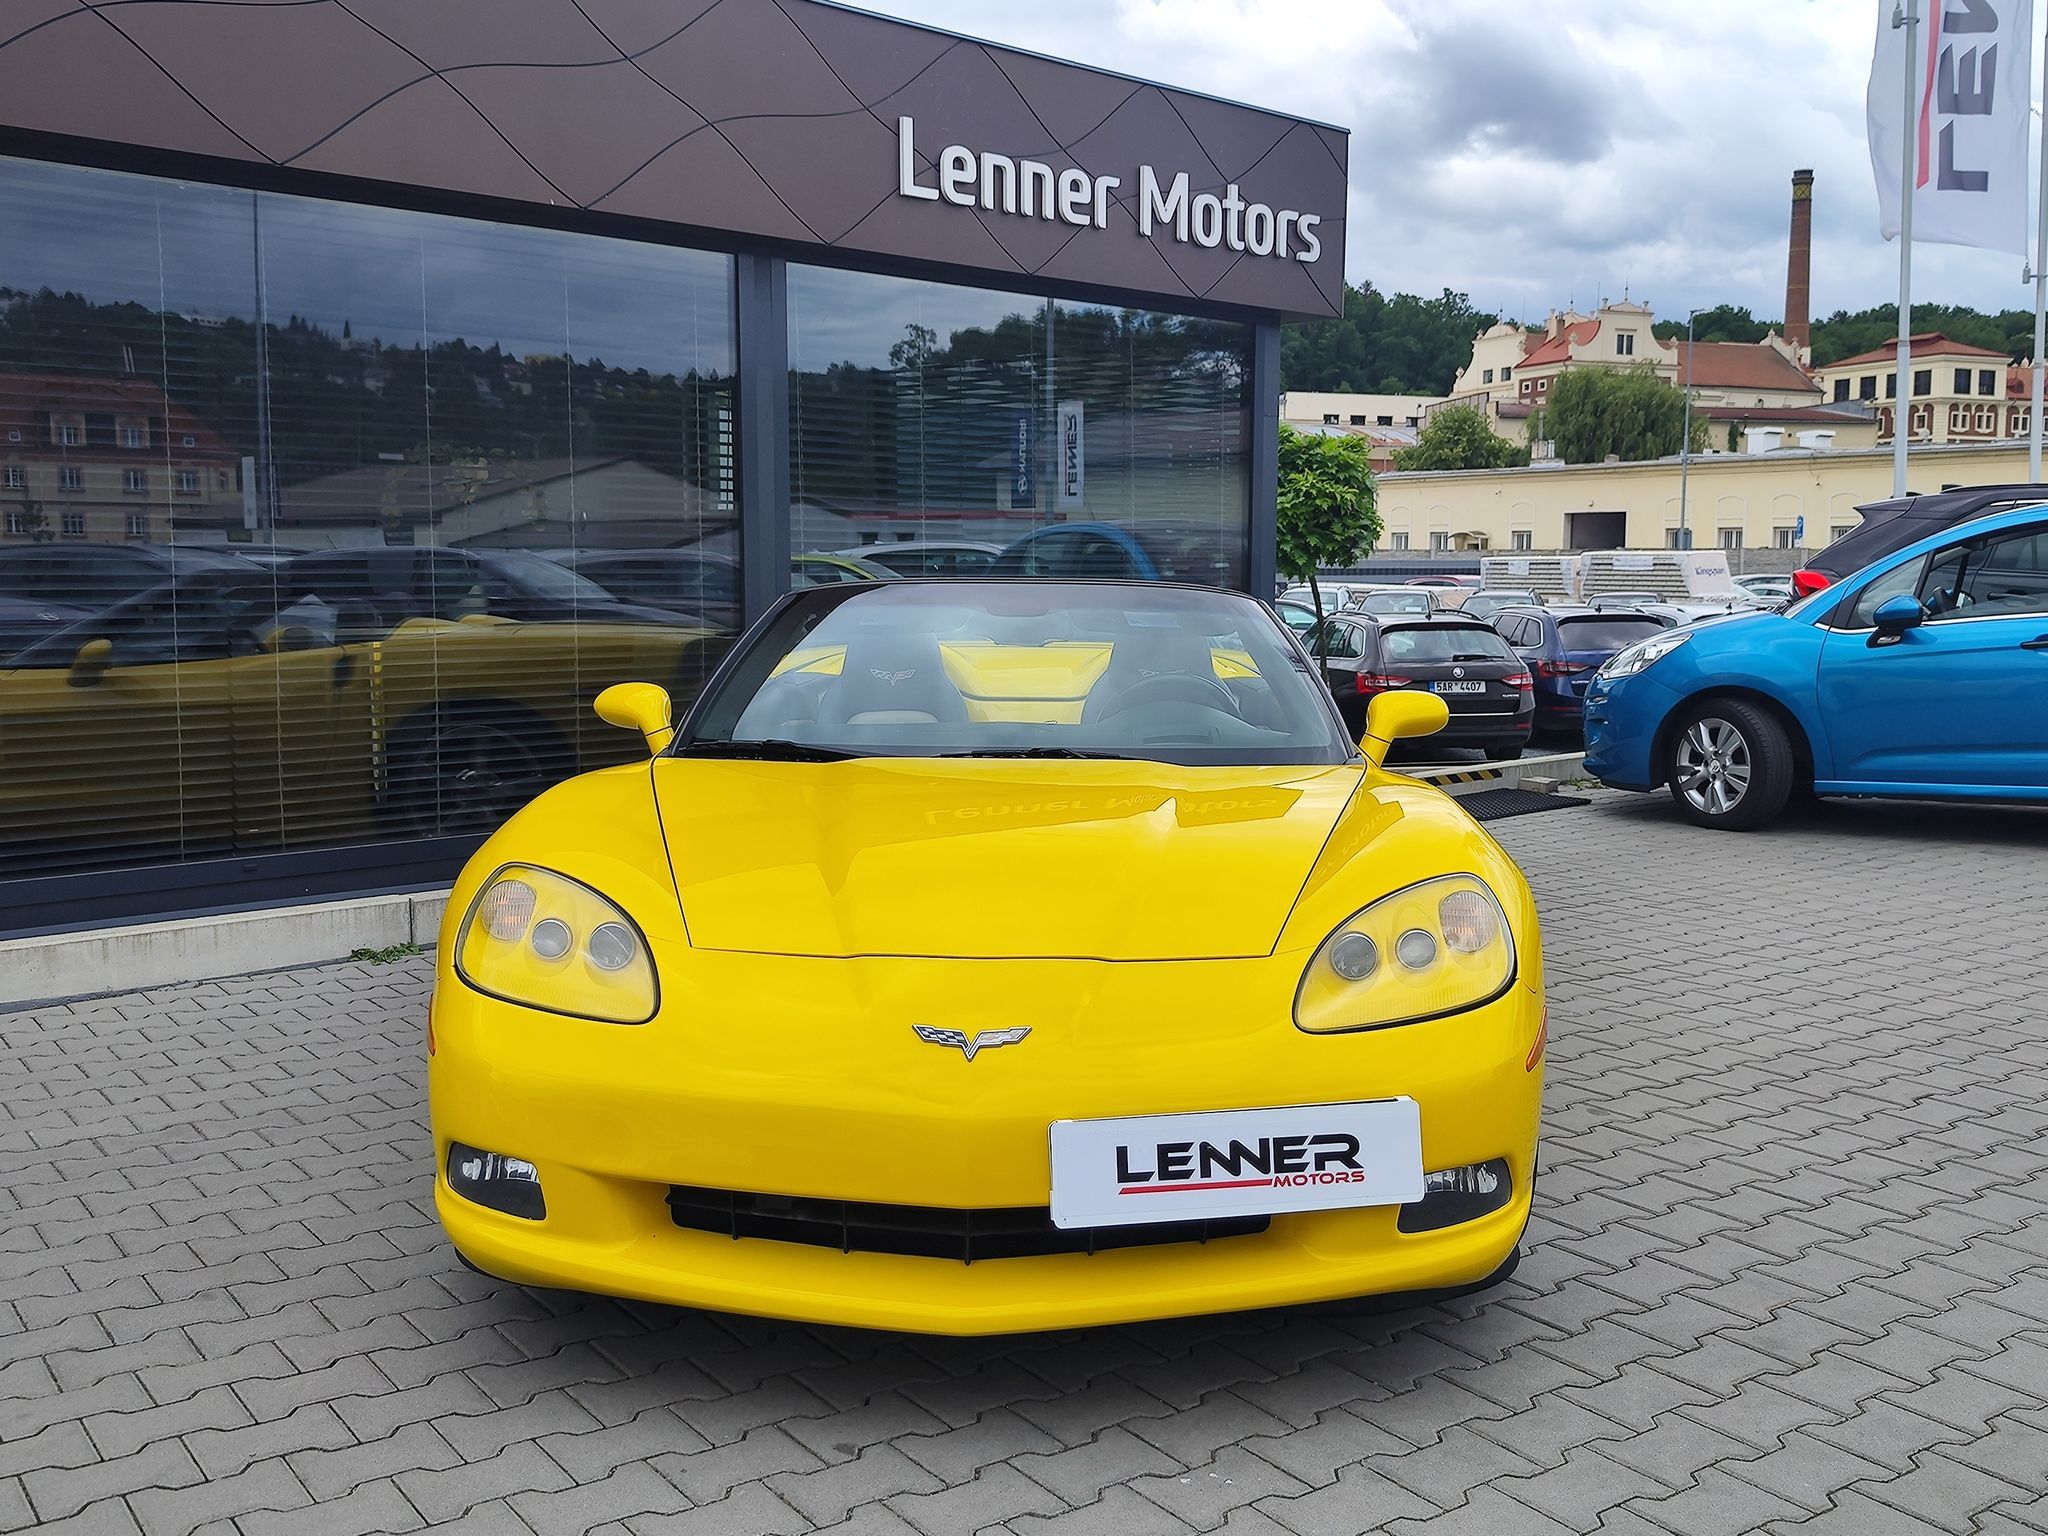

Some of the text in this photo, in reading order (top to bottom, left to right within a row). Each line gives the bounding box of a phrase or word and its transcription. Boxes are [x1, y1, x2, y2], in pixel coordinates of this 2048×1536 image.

[898, 115, 1322, 263] Lenner Motors
[1437, 682, 1453, 692] 5AR
[1460, 682, 1481, 691] 4407
[1115, 1132, 1365, 1184] LENNER
[1272, 1169, 1366, 1188] MOTORS
